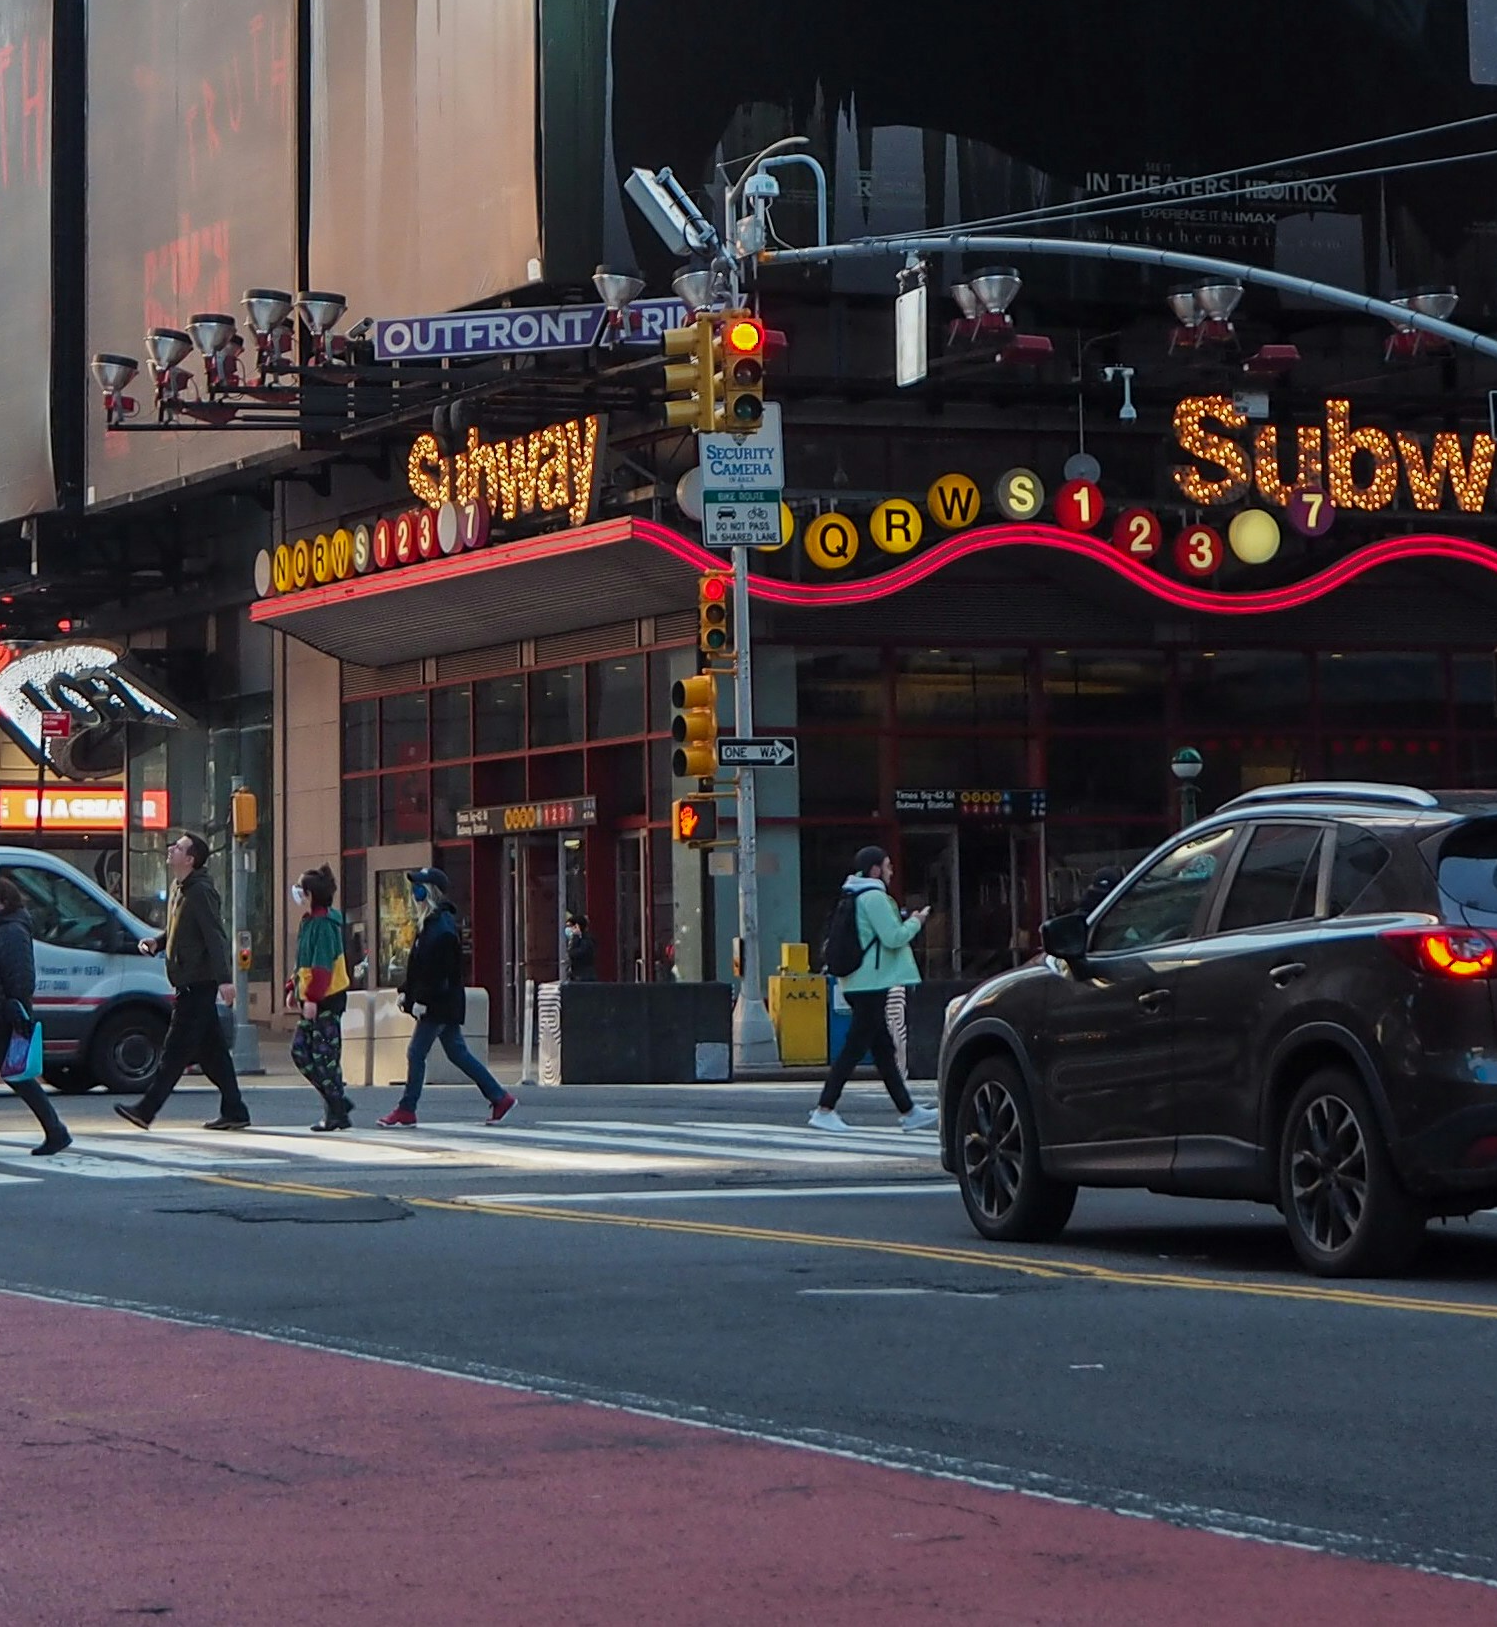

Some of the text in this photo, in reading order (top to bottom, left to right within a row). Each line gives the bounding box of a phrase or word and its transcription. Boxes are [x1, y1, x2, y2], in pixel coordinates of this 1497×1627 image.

[1085, 171, 1232, 198] IN THEATERS
[1140, 207, 1207, 223] EXPERIENCE
[1233, 210, 1277, 225] IMAX
[382, 309, 594, 355] OUTFRONT
[407, 414, 599, 527] Subway
[717, 491, 765, 502] BIKE ROUTE
[715, 522, 770, 531] DO NOT PASS
[820, 477, 1325, 568] Q R W S 1 2 3 7
[275, 505, 477, 584] N Q R W S 1 2 3 7
[709, 532, 778, 542] IN SHARED LANE
[722, 746, 783, 759] ONE WAY
[895, 799, 954, 811] Subway Station
